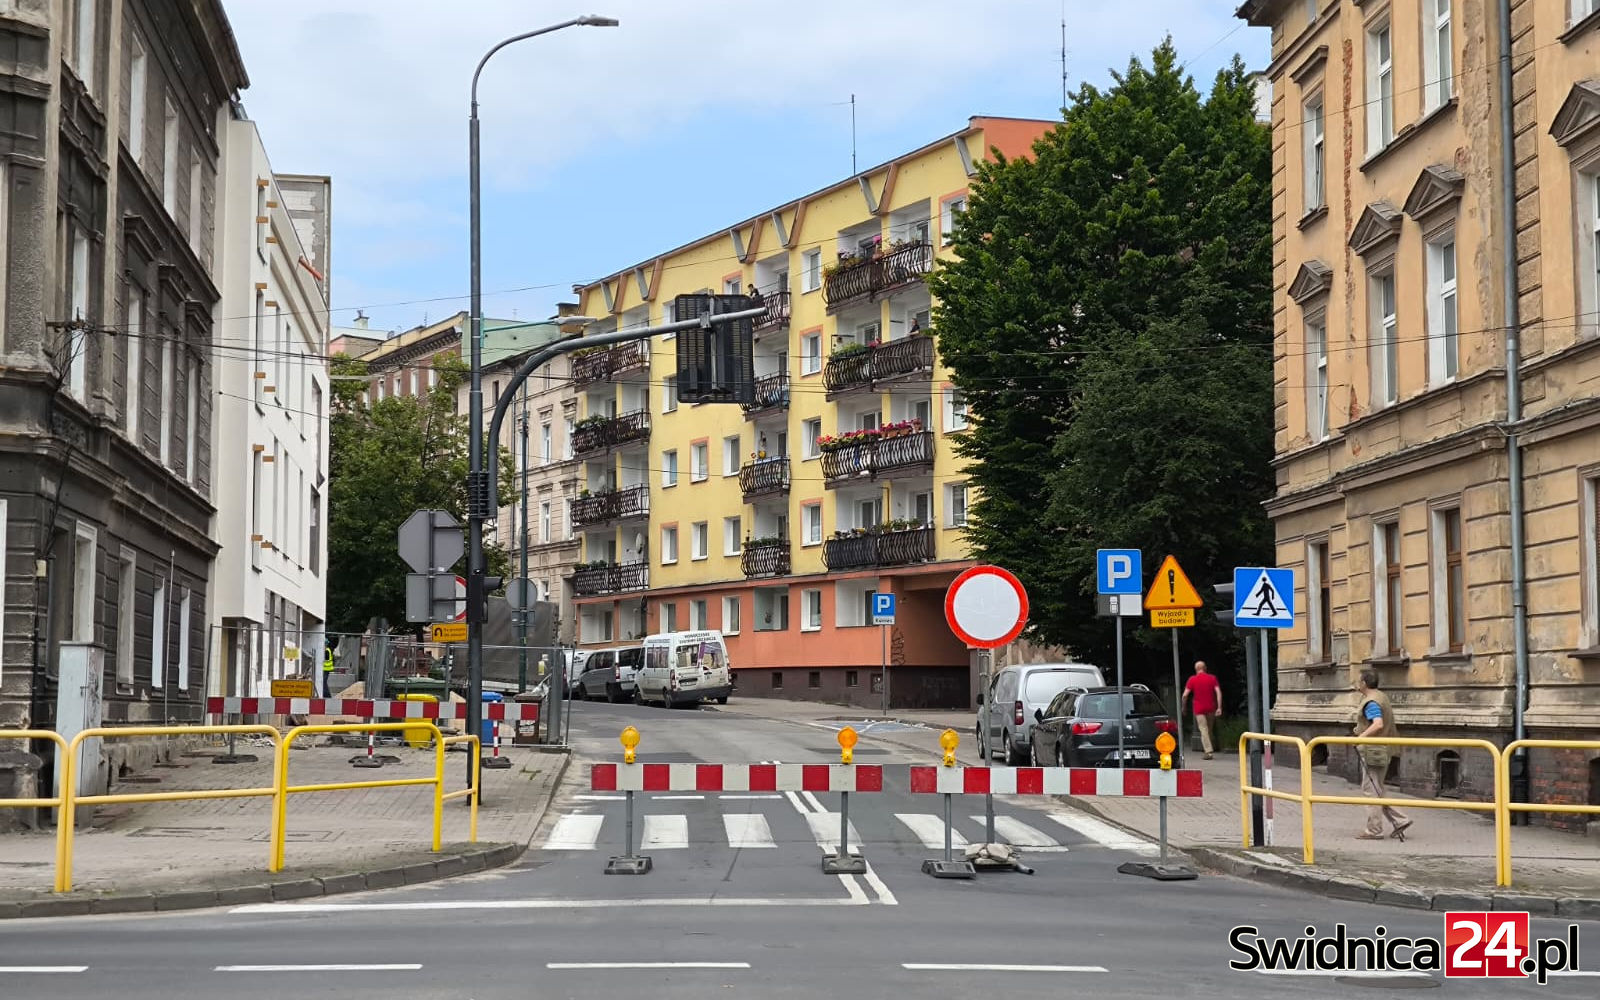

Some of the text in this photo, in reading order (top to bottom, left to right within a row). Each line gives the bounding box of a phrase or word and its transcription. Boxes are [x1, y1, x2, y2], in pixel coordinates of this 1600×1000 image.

[1107, 555, 1131, 588] P
[877, 596, 890, 613] P
[1157, 610, 1182, 618] Wyjazd
